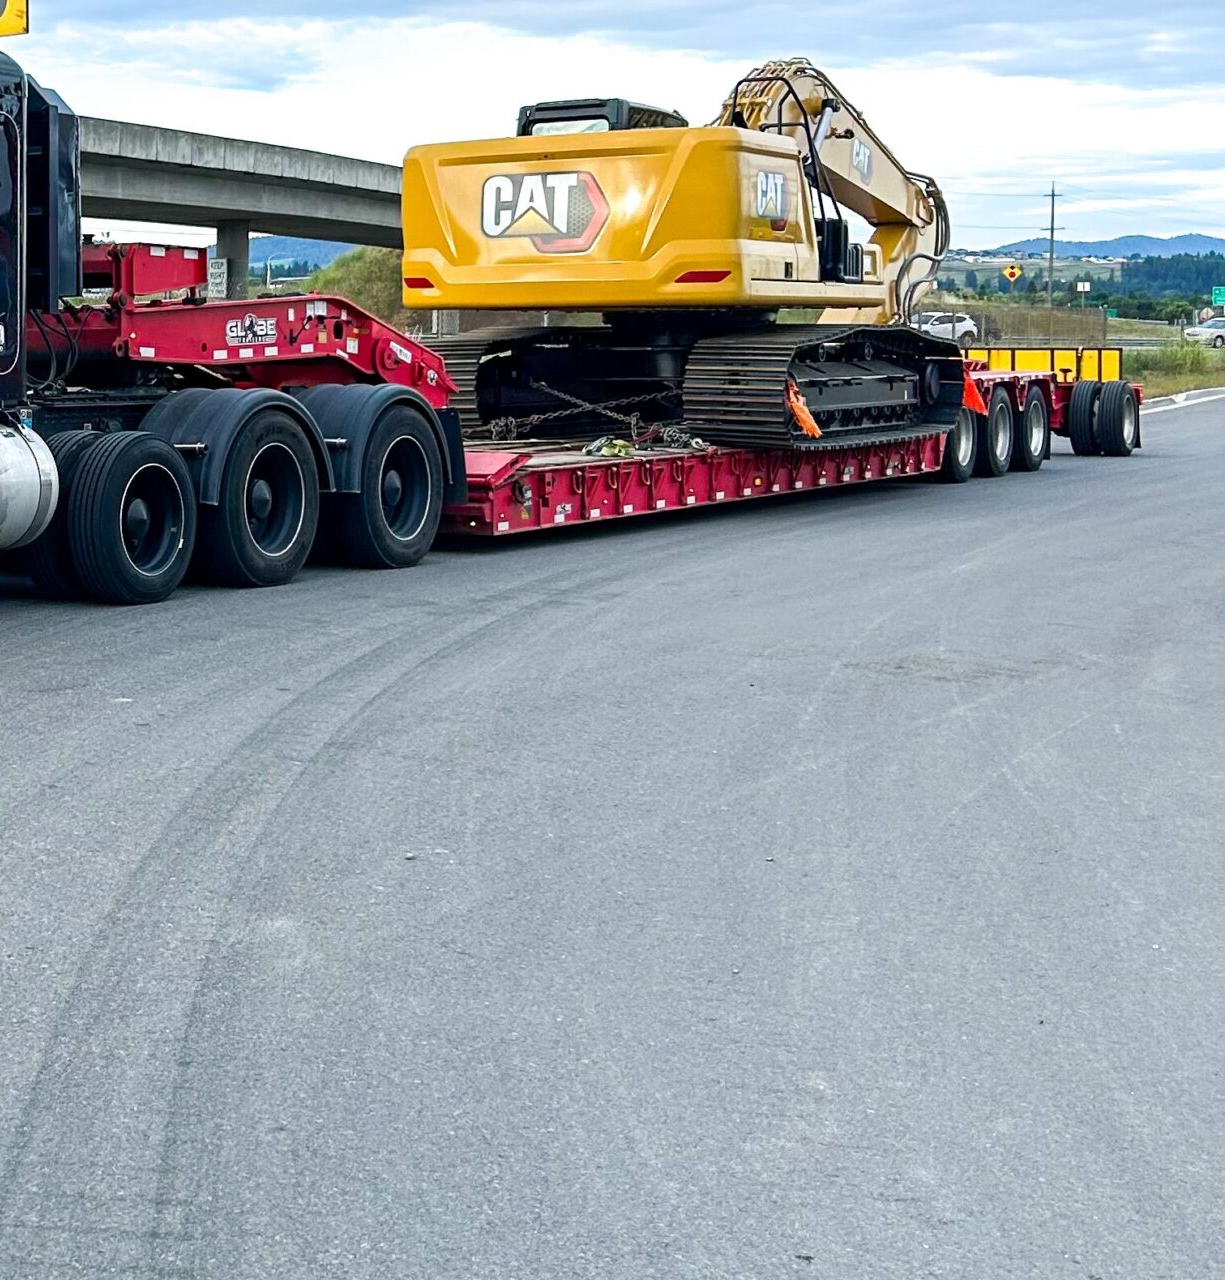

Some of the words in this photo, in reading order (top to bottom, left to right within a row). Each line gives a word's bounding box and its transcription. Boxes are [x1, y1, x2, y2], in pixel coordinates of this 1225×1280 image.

[854, 138, 871, 177] CAT
[483, 173, 578, 236] CAT
[758, 172, 783, 217] CAT
